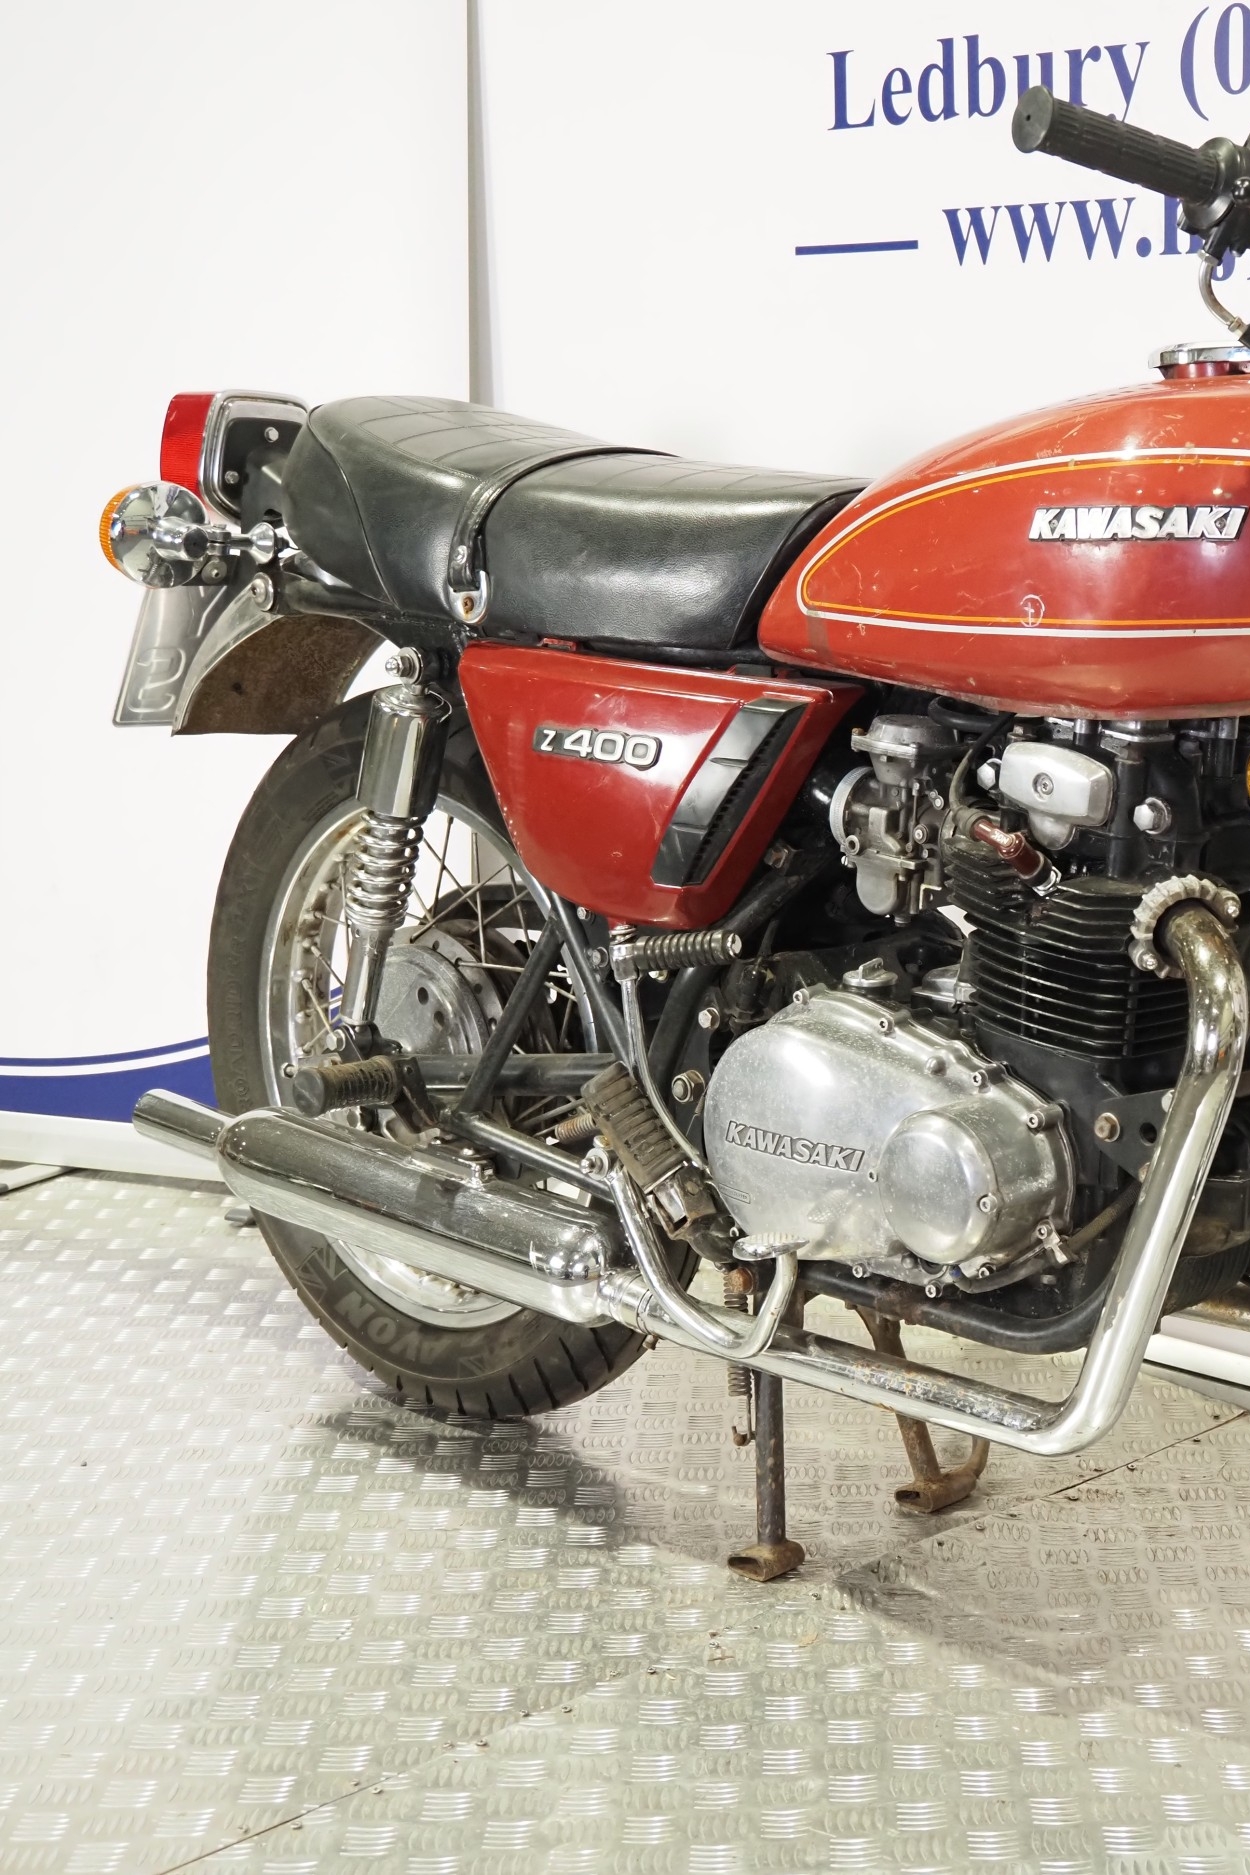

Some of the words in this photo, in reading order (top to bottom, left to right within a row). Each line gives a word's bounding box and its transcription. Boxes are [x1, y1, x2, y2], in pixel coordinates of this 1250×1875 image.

[826, 34, 1151, 131] Ledbury
[1028, 506, 1247, 540] KAWASAKI
[726, 1121, 865, 1171] KAWASAKI
[333, 1290, 451, 1364] AVON
